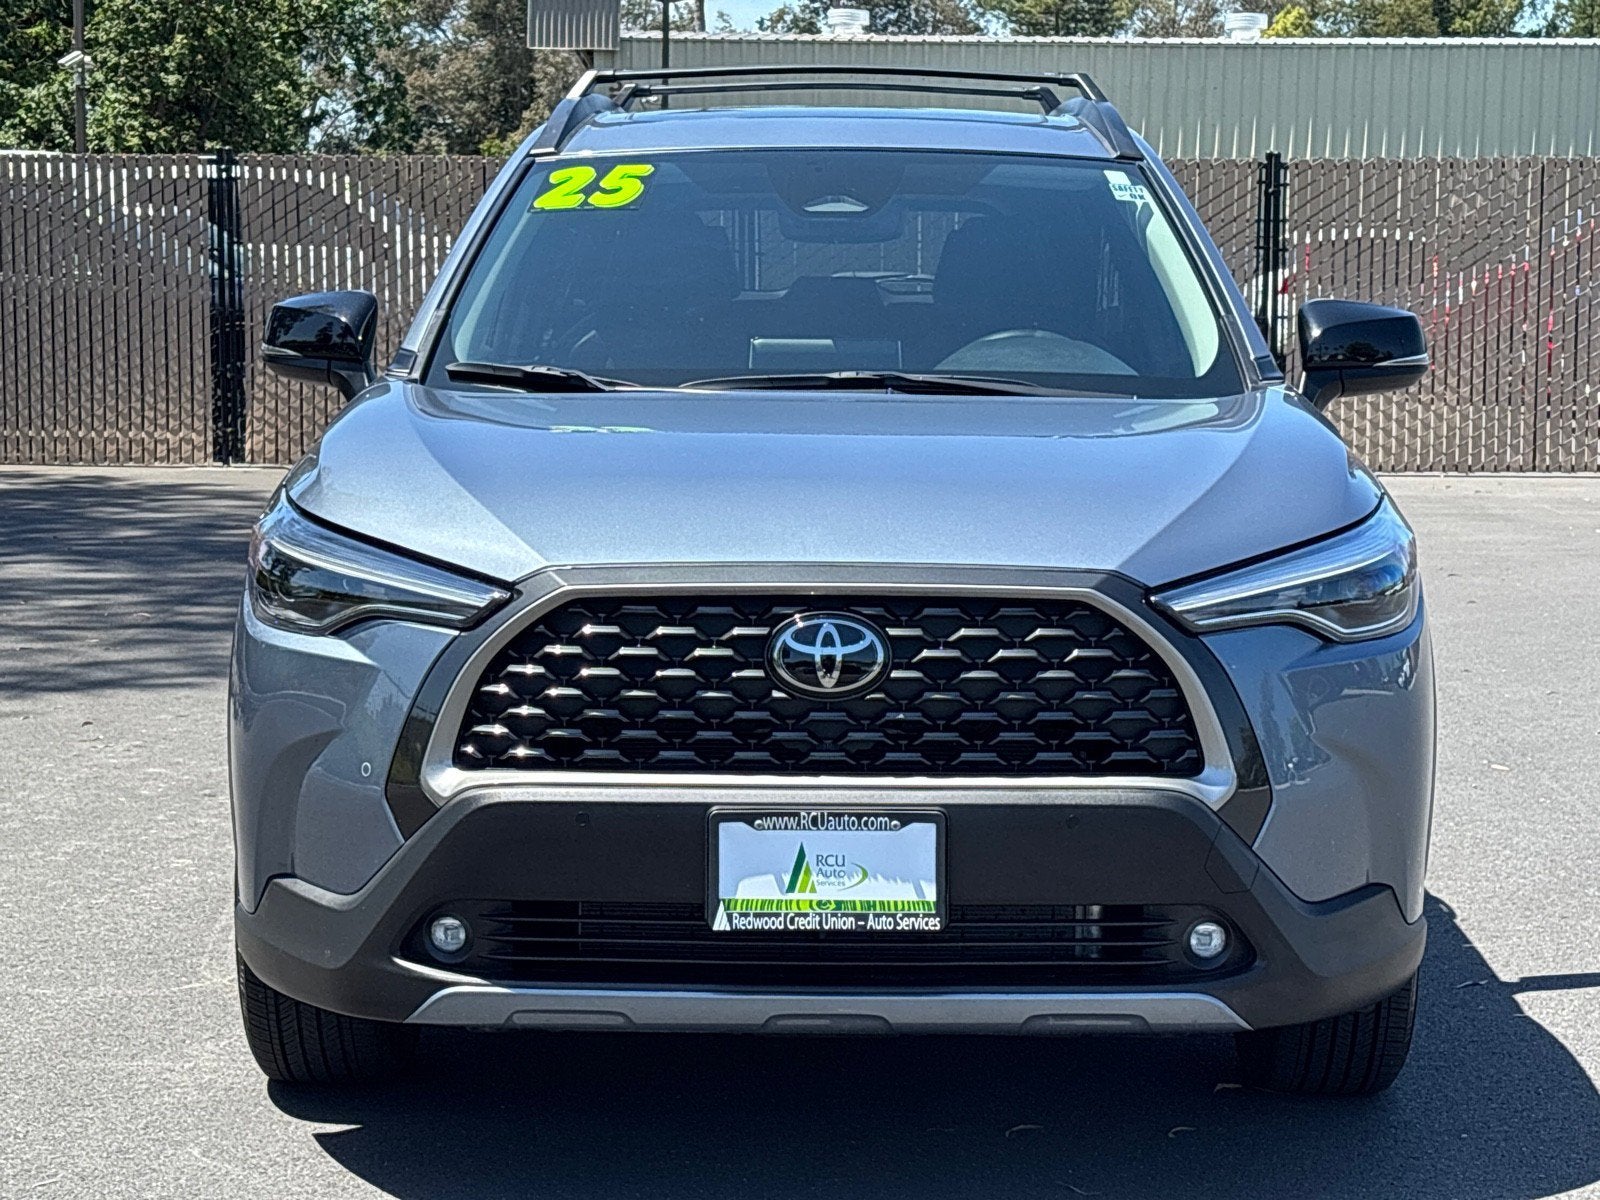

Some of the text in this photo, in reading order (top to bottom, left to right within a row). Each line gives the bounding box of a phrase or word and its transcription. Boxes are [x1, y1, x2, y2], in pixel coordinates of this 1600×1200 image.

[533, 164, 655, 209] 25
[763, 811, 890, 830] www.RCUauto.com
[816, 854, 845, 867] RCU
[817, 868, 846, 879] Auto
[732, 912, 783, 930] Redwood
[787, 912, 820, 930] Credit
[823, 912, 855, 930] Union
[867, 913, 893, 930] Auto
[896, 912, 940, 931] Services
